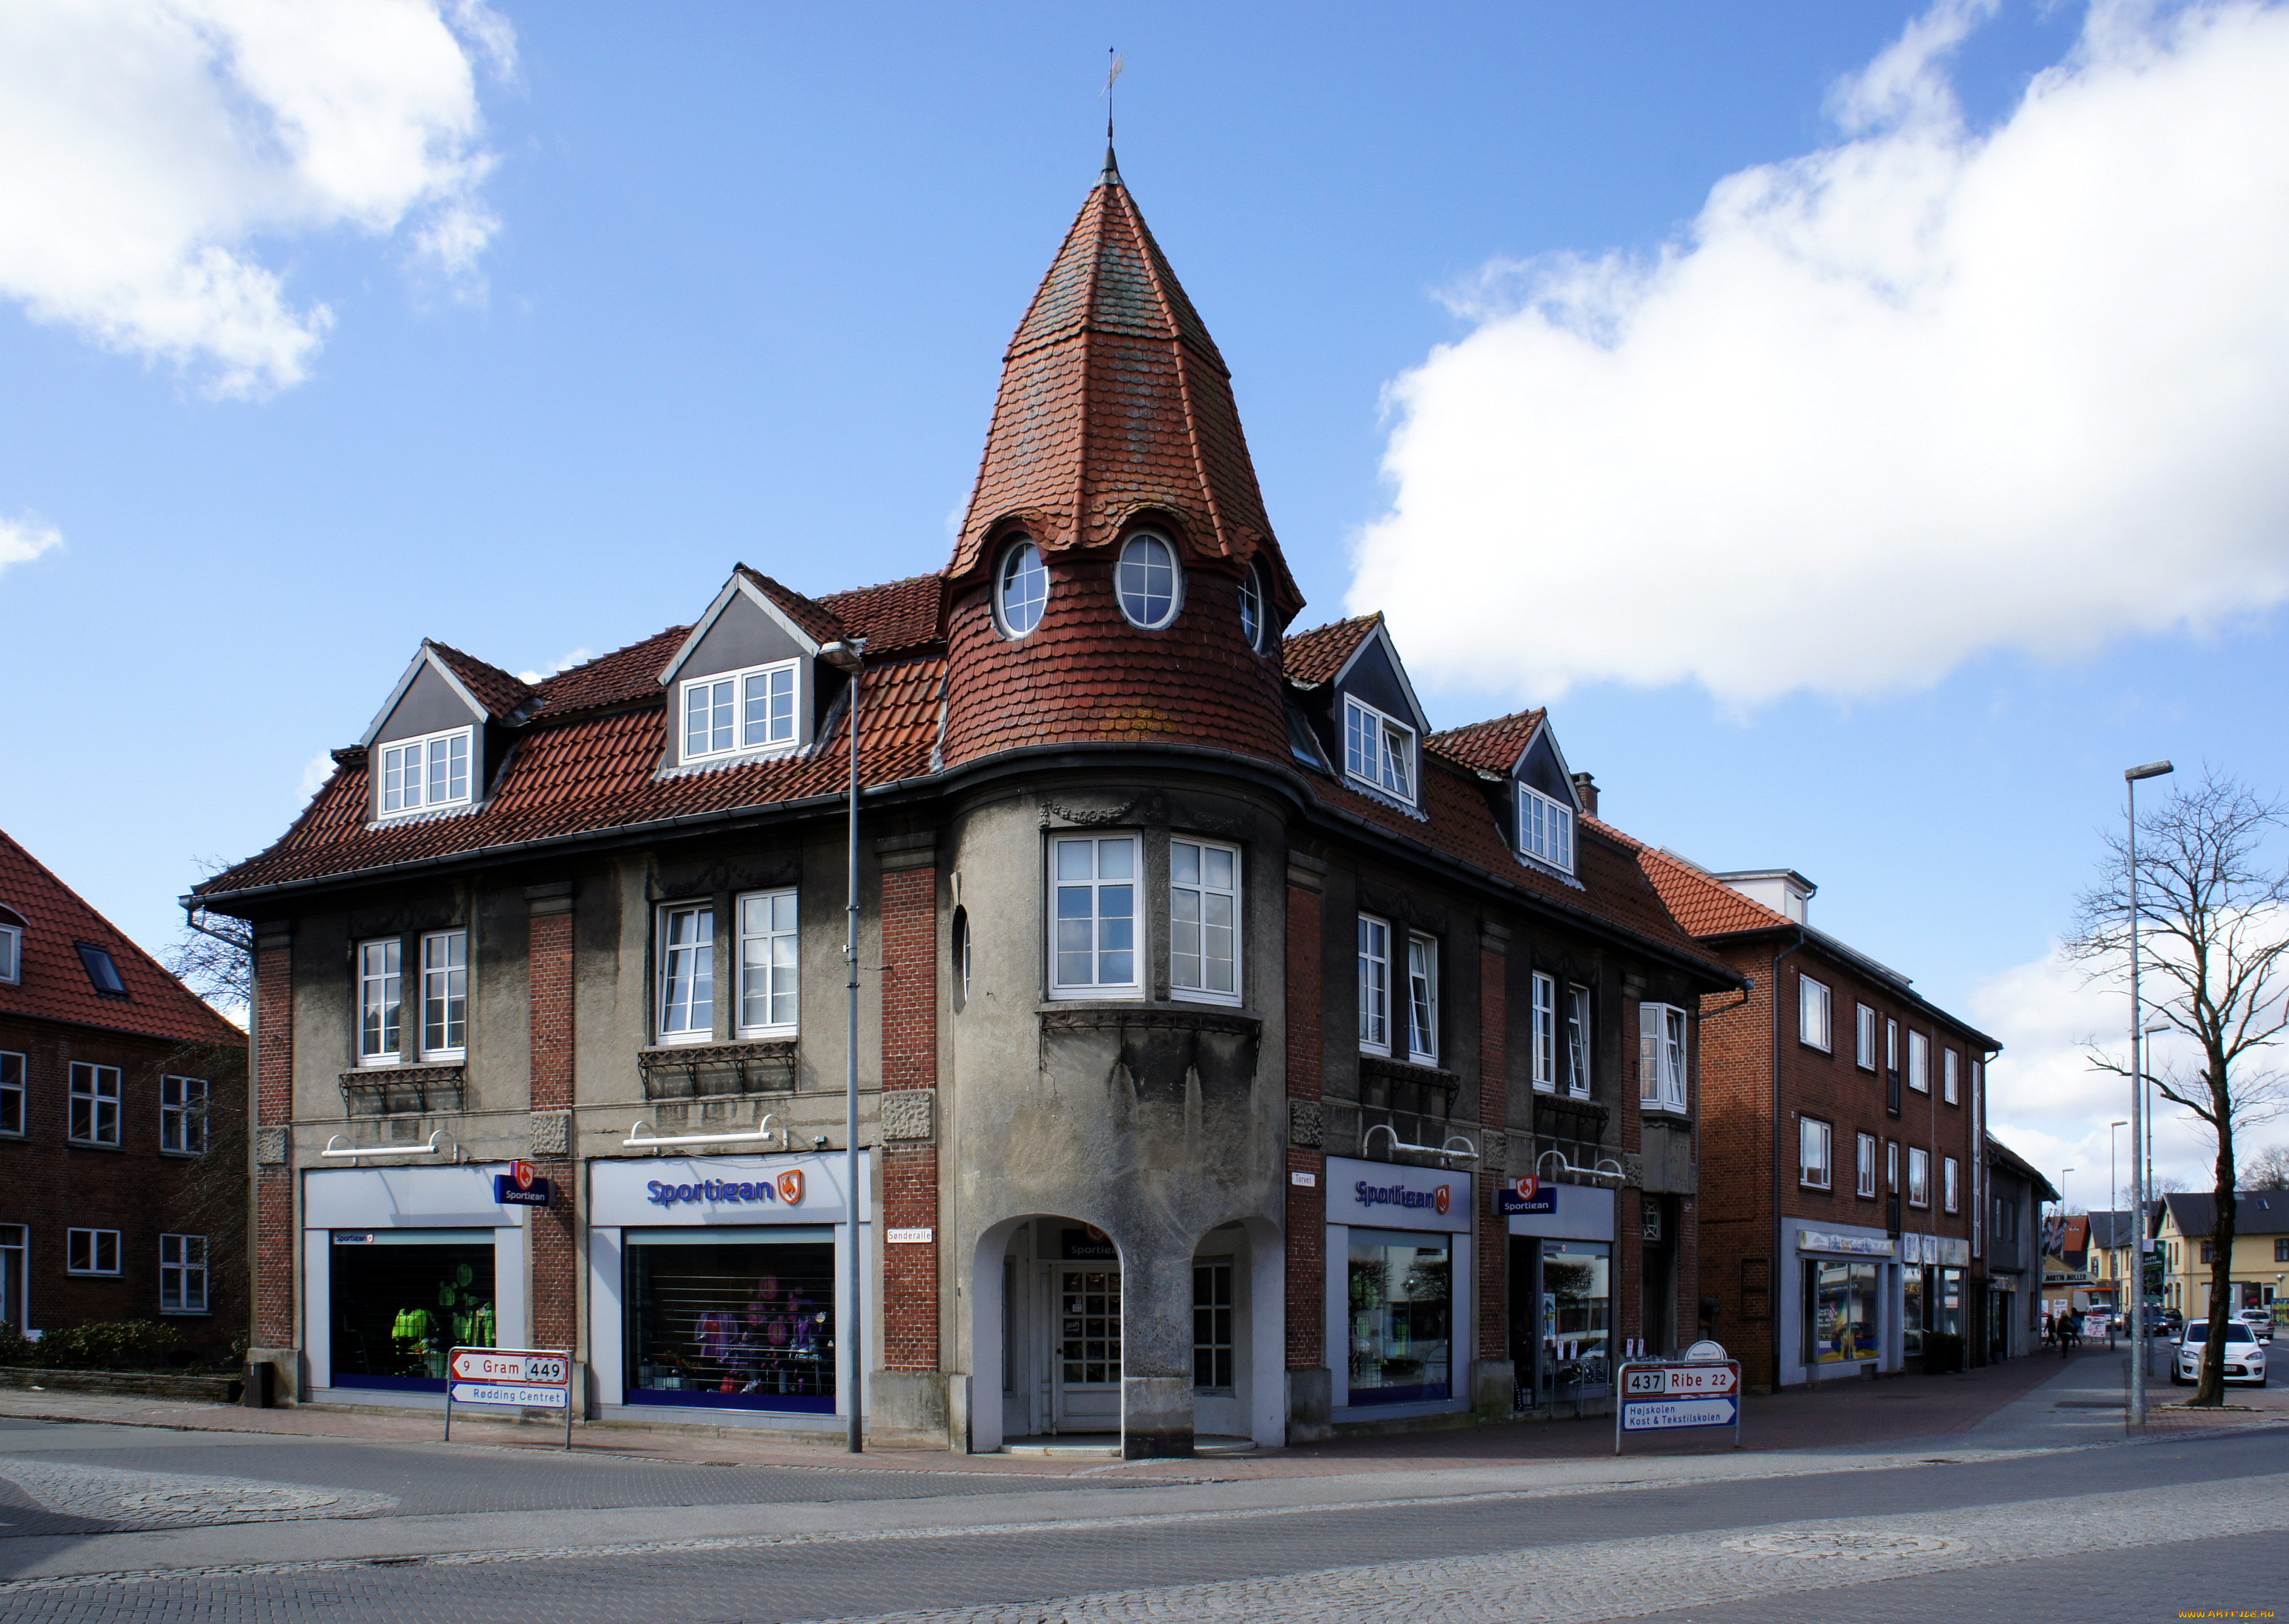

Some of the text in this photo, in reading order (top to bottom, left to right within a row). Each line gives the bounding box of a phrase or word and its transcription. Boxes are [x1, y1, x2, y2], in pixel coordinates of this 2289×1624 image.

[1295, 1174, 1312, 1184] Torvet
[506, 1190, 545, 1201] Sportigan
[647, 1178, 774, 1206] Sportigan
[1356, 1181, 1435, 1208] Sportigan
[1504, 1202, 1549, 1211] Sportigan
[336, 1234, 367, 1242] Sportigan
[888, 1230, 931, 1239] Sønderalle
[1071, 1245, 1116, 1255] Sportiga
[464, 1359, 519, 1374] 9 Gram
[530, 1363, 560, 1377] 449
[1632, 1374, 1661, 1390] 437
[1671, 1374, 1726, 1388] Ribe 22
[473, 1389, 560, 1403] Rødding Centret
[1630, 1405, 1675, 1416] Højskolen
[1630, 1413, 1720, 1426] Kost & Tekstilskolen
